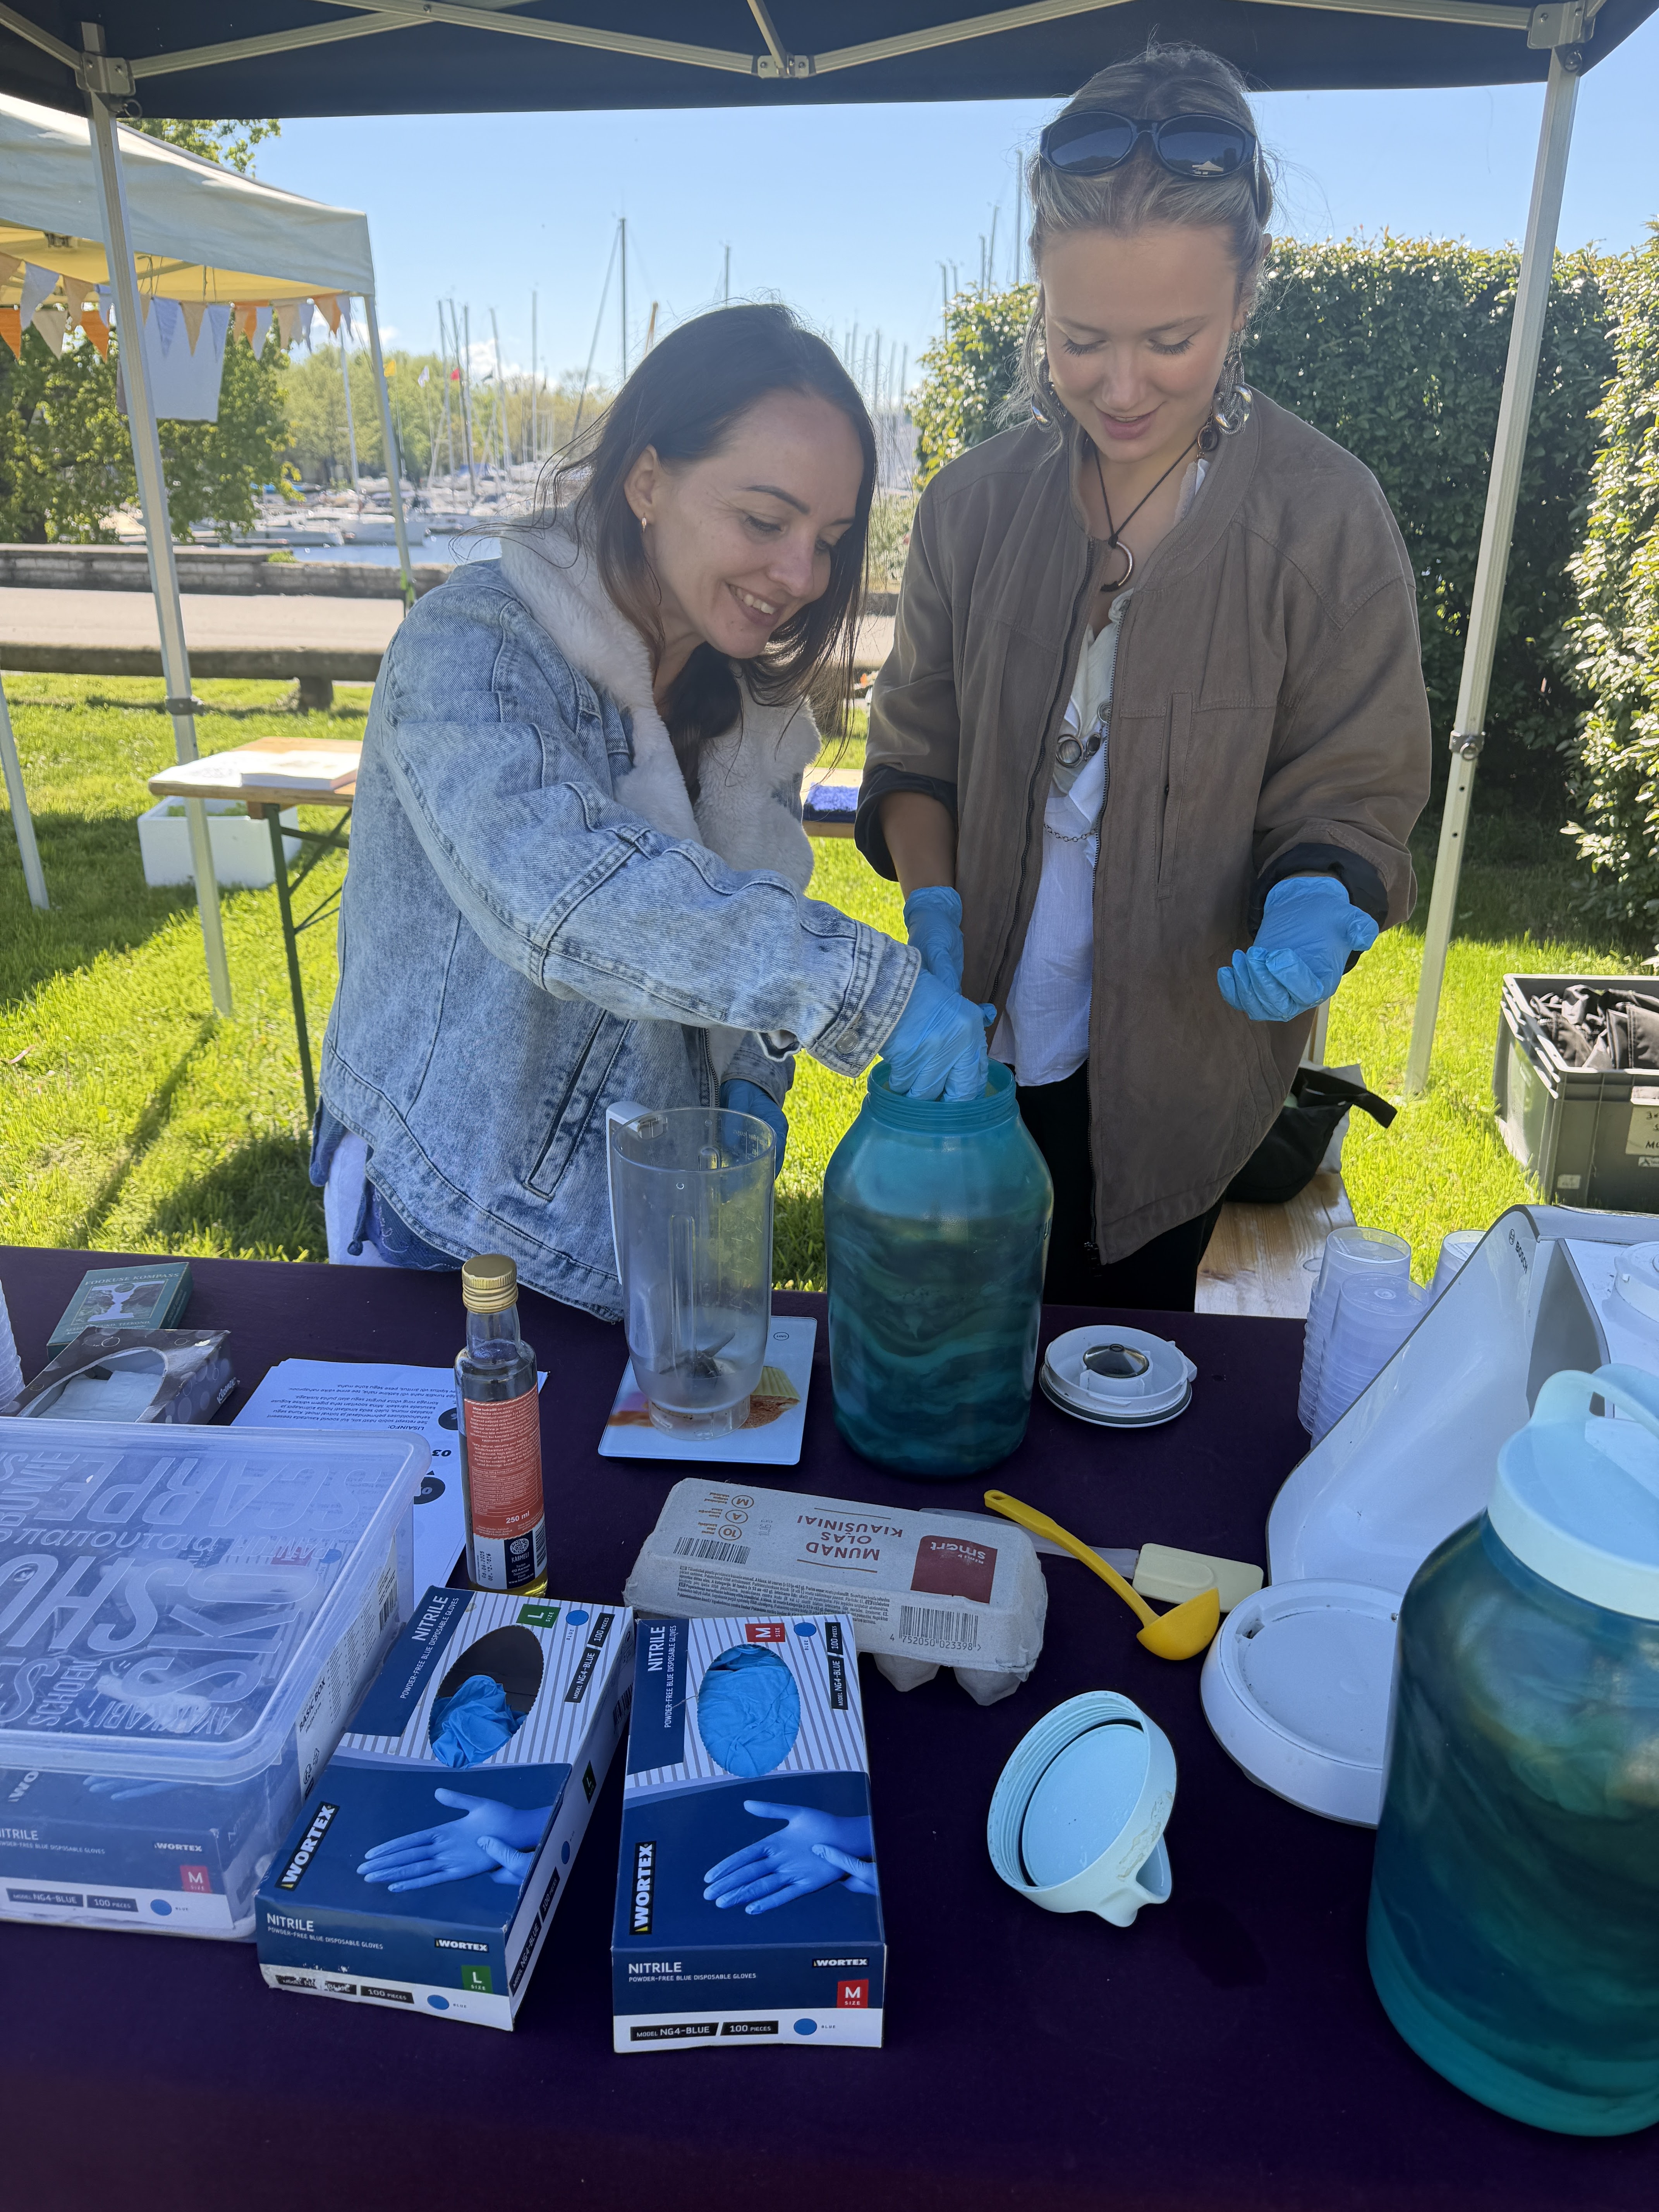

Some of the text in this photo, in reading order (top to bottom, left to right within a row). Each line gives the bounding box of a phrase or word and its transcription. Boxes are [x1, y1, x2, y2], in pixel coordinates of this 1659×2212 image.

[1515, 1241, 1528, 1274] BOSCH
[85, 1273, 179, 1285] FOOKUSE KOMPASS
[33, 1453, 387, 1531] SCARPE
[736, 1498, 749, 1506] M
[506, 1515, 520, 1524] 250
[521, 1510, 530, 1520] ml
[723, 1528, 736, 1537] 10
[797, 1515, 903, 1539] KIAUŠINIAI
[512, 1552, 529, 1563] KARMELI
[805, 1542, 880, 1561] MUNAD
[931, 1541, 986, 1561] smart
[412, 1595, 449, 1642] NITRILE
[546, 1611, 554, 1623] SIZE
[566, 1628, 574, 1640] BLUE
[669, 1625, 677, 1642] GLOVES
[755, 1627, 771, 1638] M
[400, 1596, 459, 1699] POWDER-FREE BLUE DISPOSABLE GLOVES
[647, 1626, 665, 1671] NITRILE
[830, 1638, 838, 1649] 100
[902, 1635, 935, 1646] 752050
[939, 1640, 973, 1650] 023398
[572, 1617, 609, 1699] MODEL NG4-BLUE 100 PIECES
[667, 1643, 675, 1671] DISPOSABLE
[832, 1660, 842, 1691] NG4-BLUE
[298, 1699, 315, 1733] BASIC
[312, 1676, 326, 1703] BOX
[664, 1688, 673, 1727] POWDER-FREE
[156, 1842, 202, 1852] WORTEX
[282, 1804, 335, 1886] WORTEX
[188, 1871, 203, 1884] M
[634, 1844, 652, 1927] WORTEX
[33, 1893, 77, 1904] NG4-BLUE
[94, 1898, 110, 1907] 100
[266, 1912, 314, 1932] NITRILE
[267, 1927, 383, 1950] POWDER-FREE BLUE DISPOSABLE GLOVES
[520, 1893, 550, 1969] NG4-BLUE 100
[438, 1939, 487, 1952] WORTEX
[629, 1962, 682, 1974] NITRILE
[472, 1971, 482, 1984] L
[367, 1988, 385, 1997] 100
[845, 1986, 861, 1998] M
[660, 2025, 710, 2036] NG4-BLUE
[729, 2024, 748, 2033] 100
